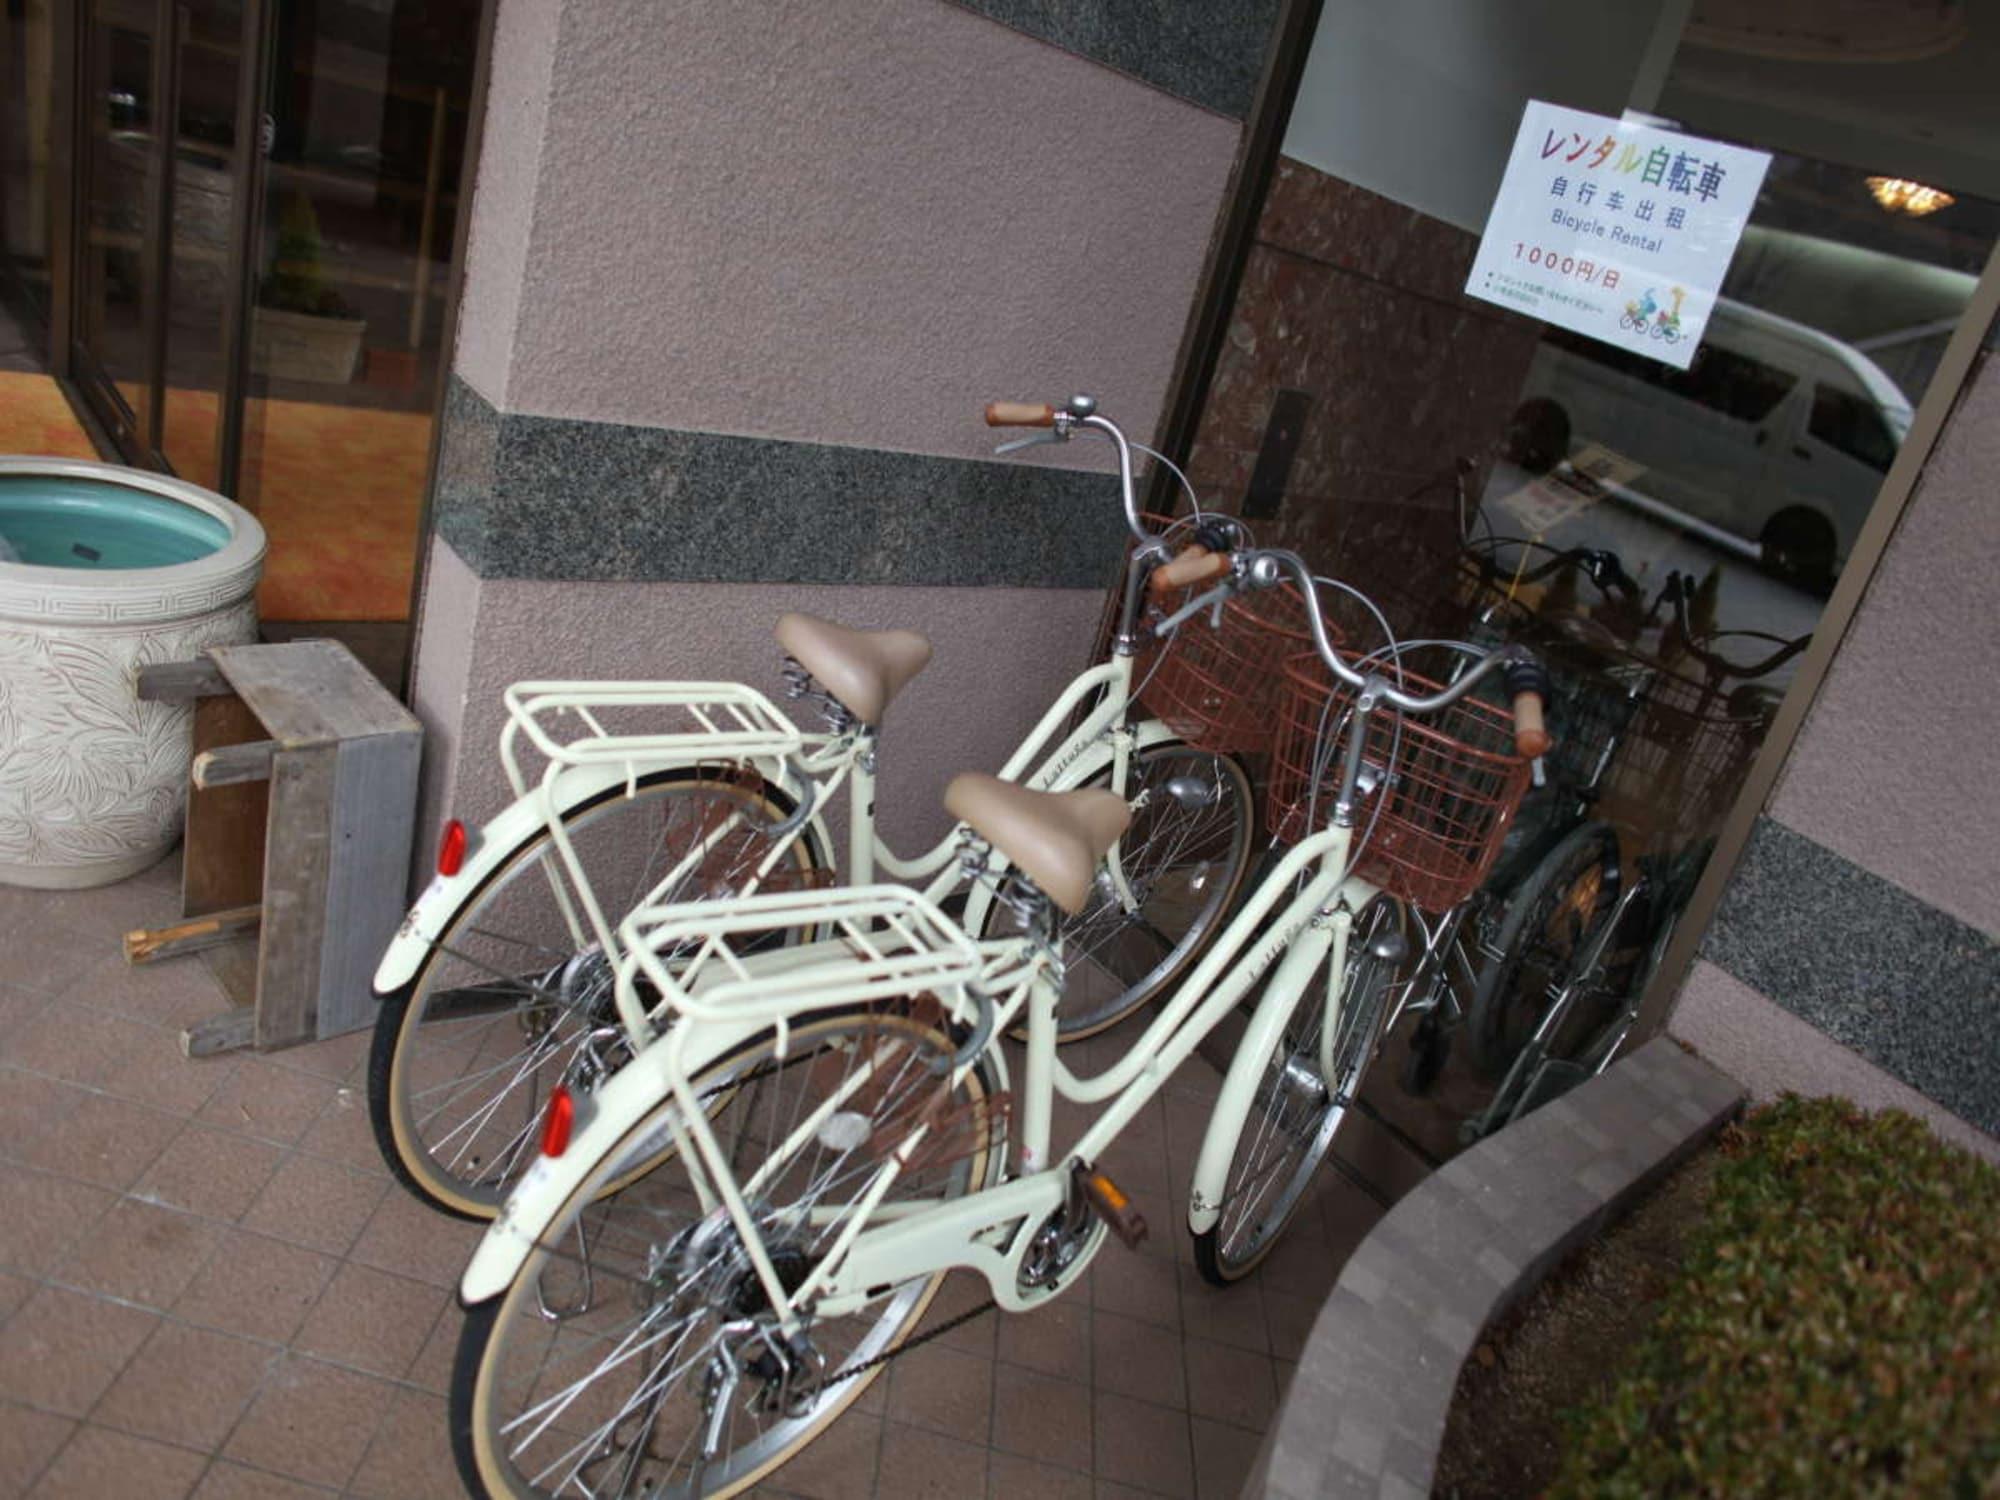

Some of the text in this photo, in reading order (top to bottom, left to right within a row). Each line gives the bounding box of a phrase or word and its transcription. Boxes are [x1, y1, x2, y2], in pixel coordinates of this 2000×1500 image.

[1541, 128, 1727, 203] レンタル自転車
[1551, 176, 1687, 230] 自行车出租
[1551, 207, 1663, 253] Bicycle Rental
[1513, 242, 1621, 289] 1000円/日
